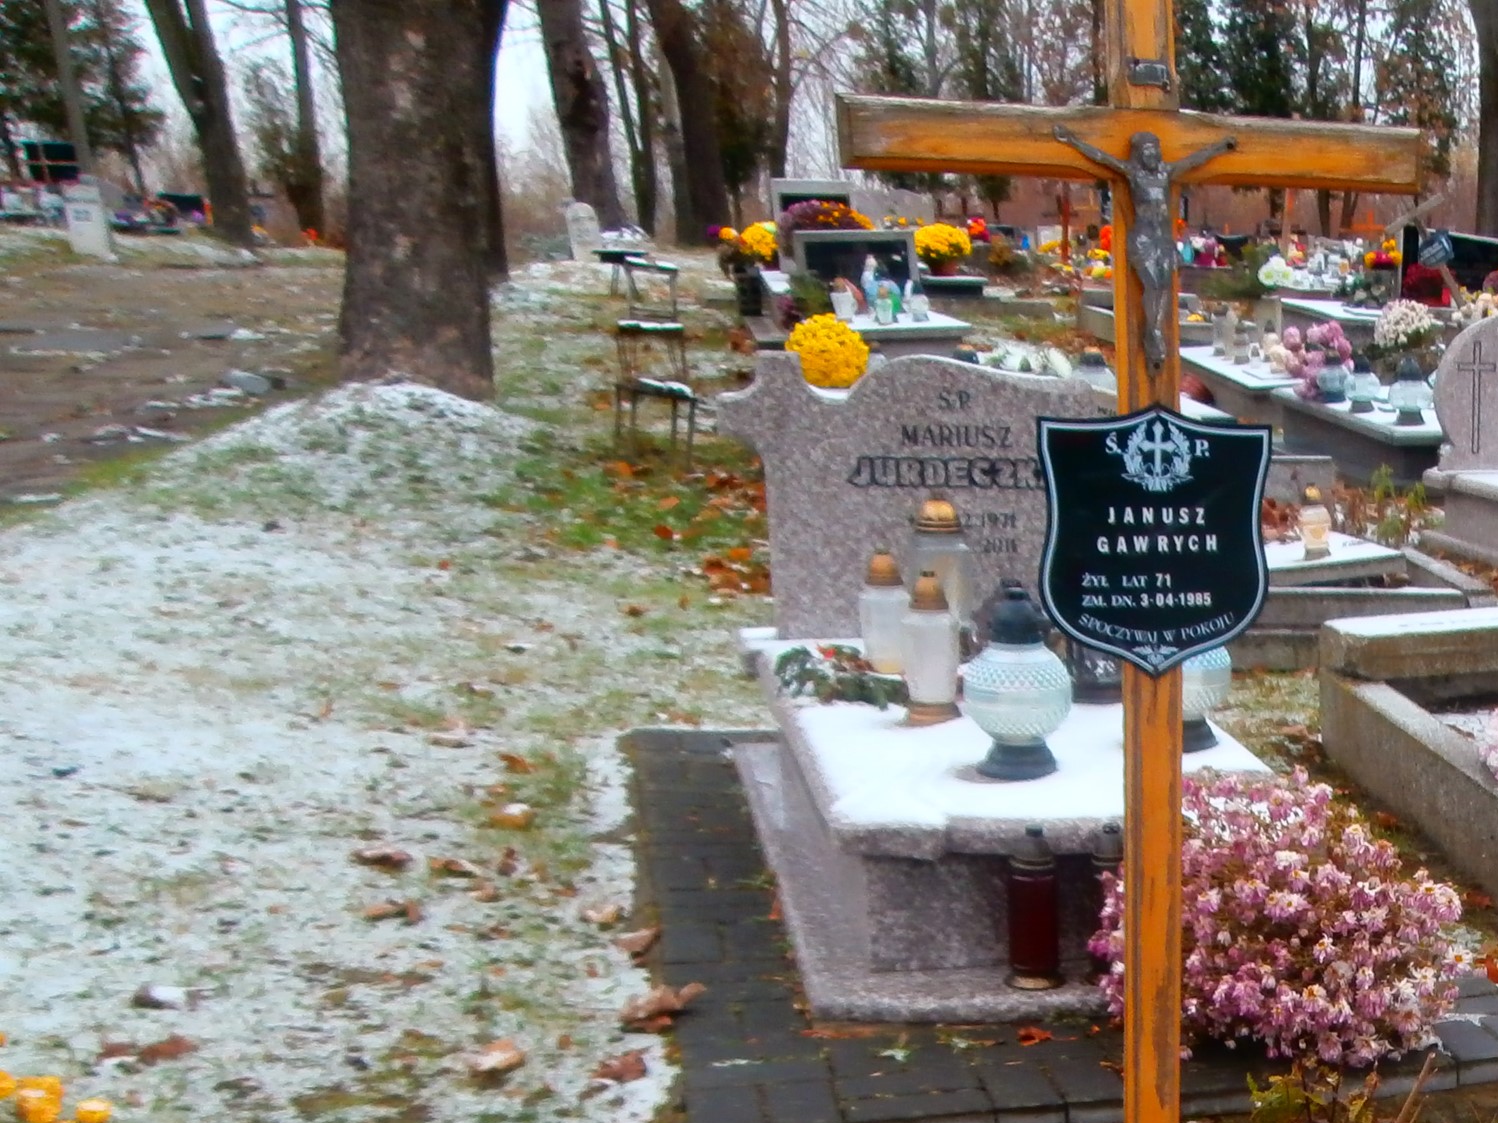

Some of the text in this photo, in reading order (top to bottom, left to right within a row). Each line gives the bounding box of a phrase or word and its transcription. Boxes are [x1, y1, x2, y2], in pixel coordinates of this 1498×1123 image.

[901, 424, 1013, 449] MARIUSZ
[1107, 506, 1206, 526] JANUSZ
[1096, 534, 1218, 554] GAWRYCH
[1081, 572, 1171, 588] ŻYŁ LAT 71
[1081, 594, 1107, 608] ZM.
[1111, 593, 1136, 608] DN.
[1078, 611, 1235, 643] SPOCZYWAJ W POKOJU
